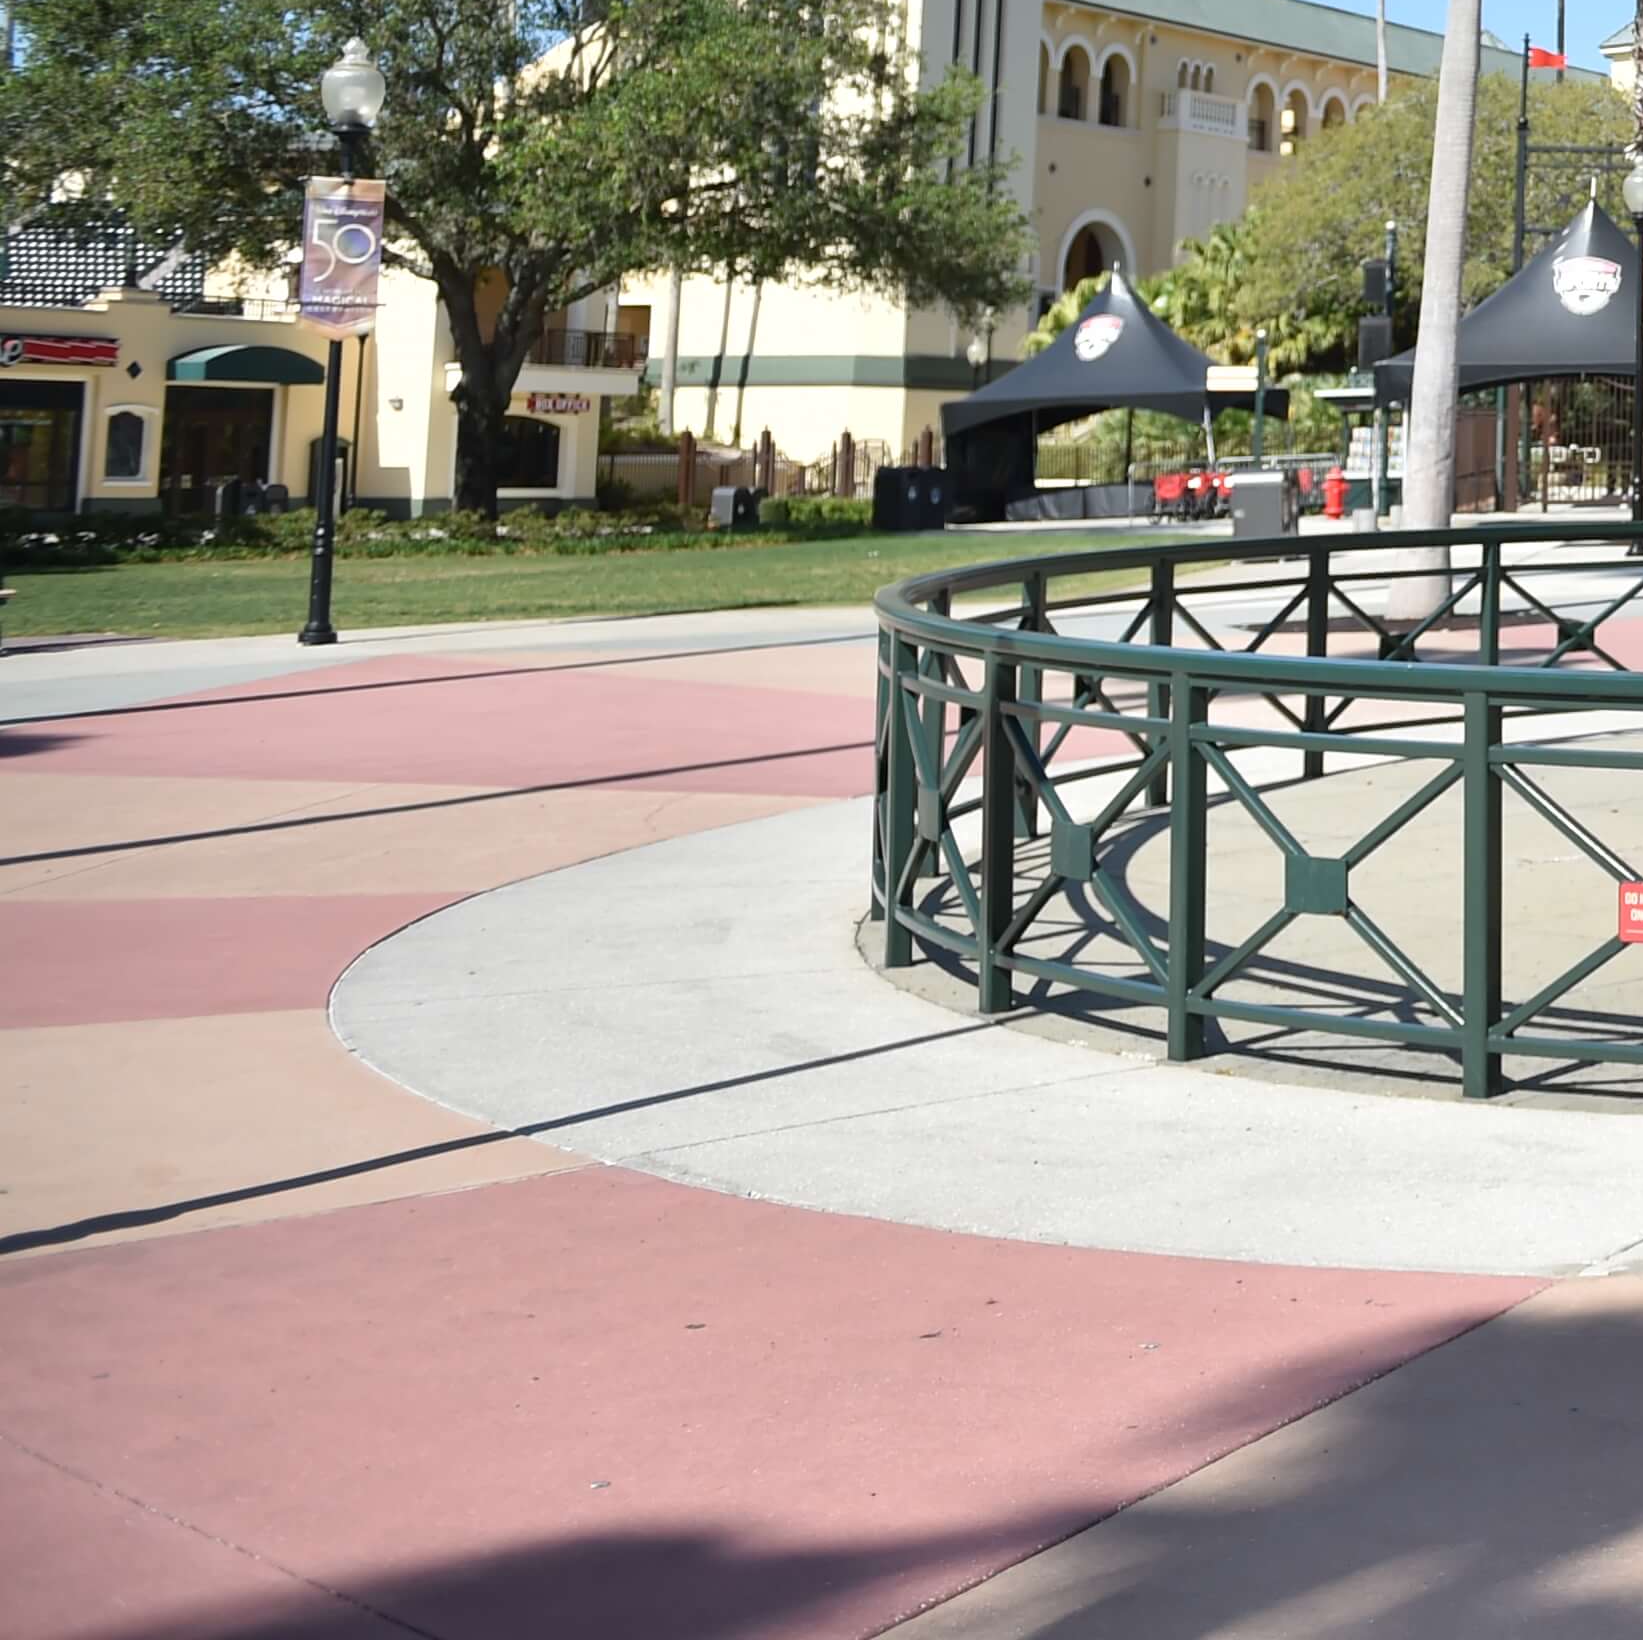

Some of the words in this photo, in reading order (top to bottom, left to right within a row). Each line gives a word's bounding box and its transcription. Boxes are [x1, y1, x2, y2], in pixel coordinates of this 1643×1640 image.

[311, 219, 376, 282] 50
[1624, 892, 1638, 905] DO
[1630, 908, 1643, 922] ON
